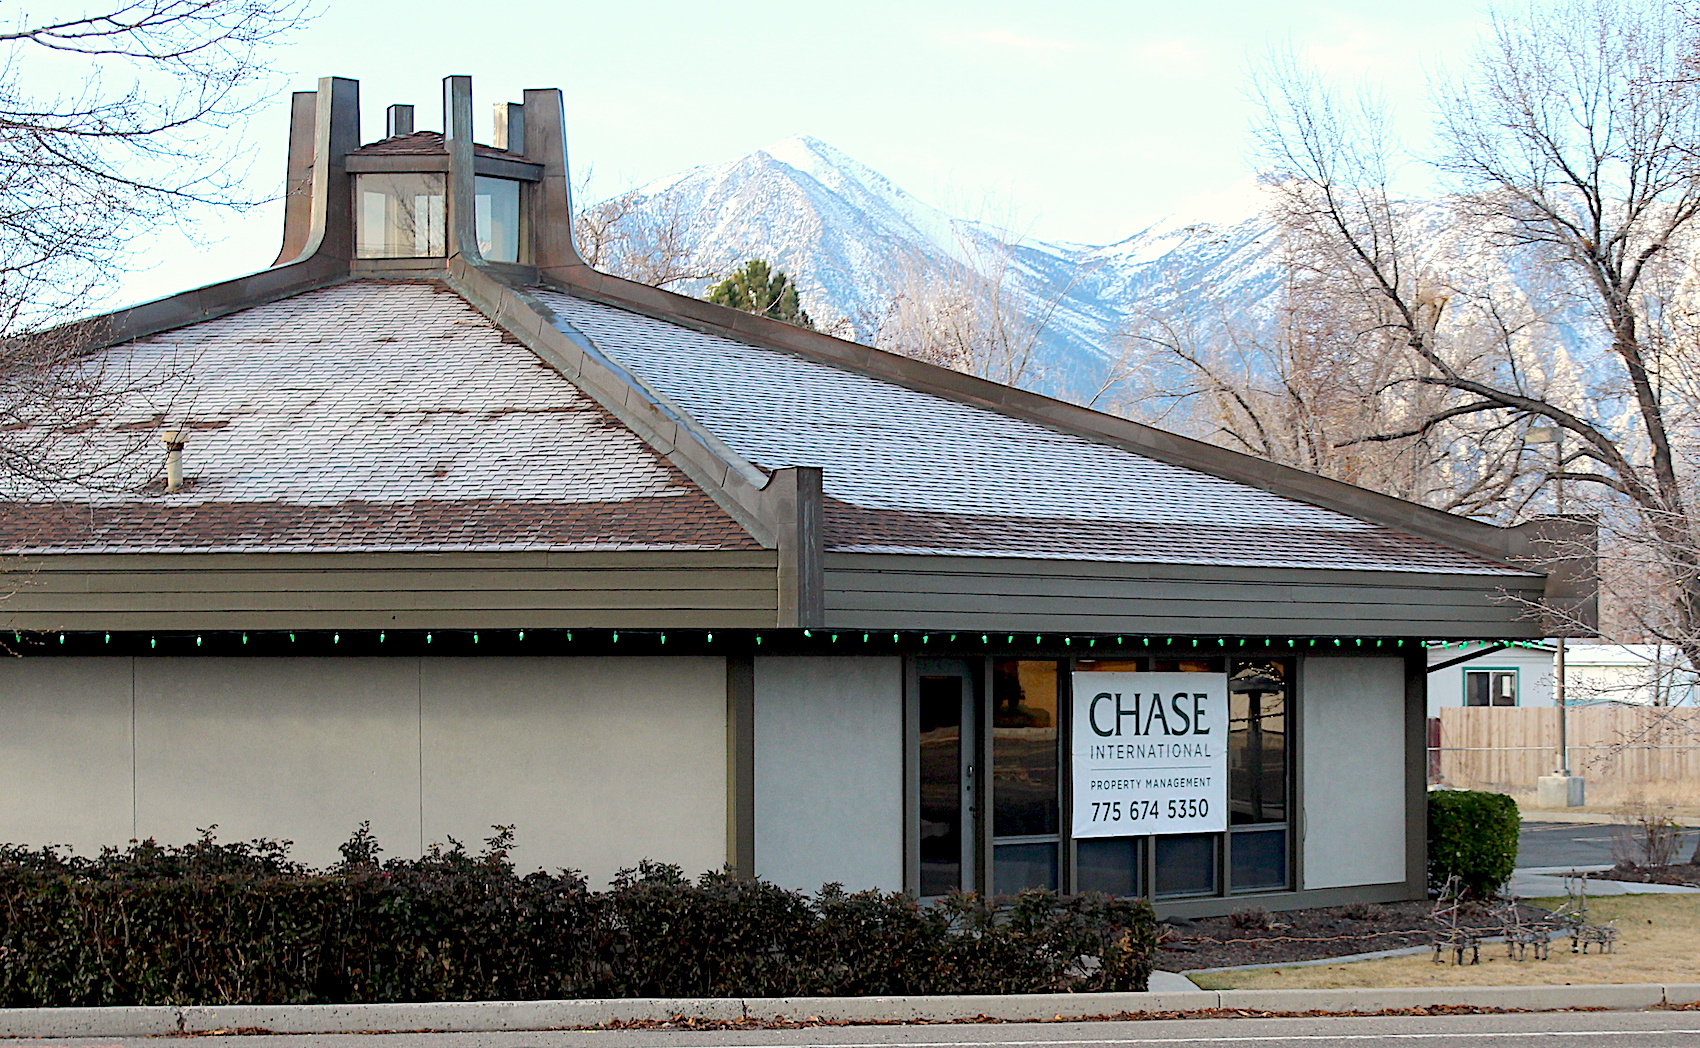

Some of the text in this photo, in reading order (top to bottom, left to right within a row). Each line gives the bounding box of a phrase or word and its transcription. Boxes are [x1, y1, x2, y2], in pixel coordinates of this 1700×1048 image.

[1089, 692, 1211, 737] CHASE
[1090, 743, 1211, 759] INTERNATIONAL
[1090, 777, 1211, 790] PROPERTY MANAGEMENT
[1091, 798, 1209, 822] 775 674 5350
